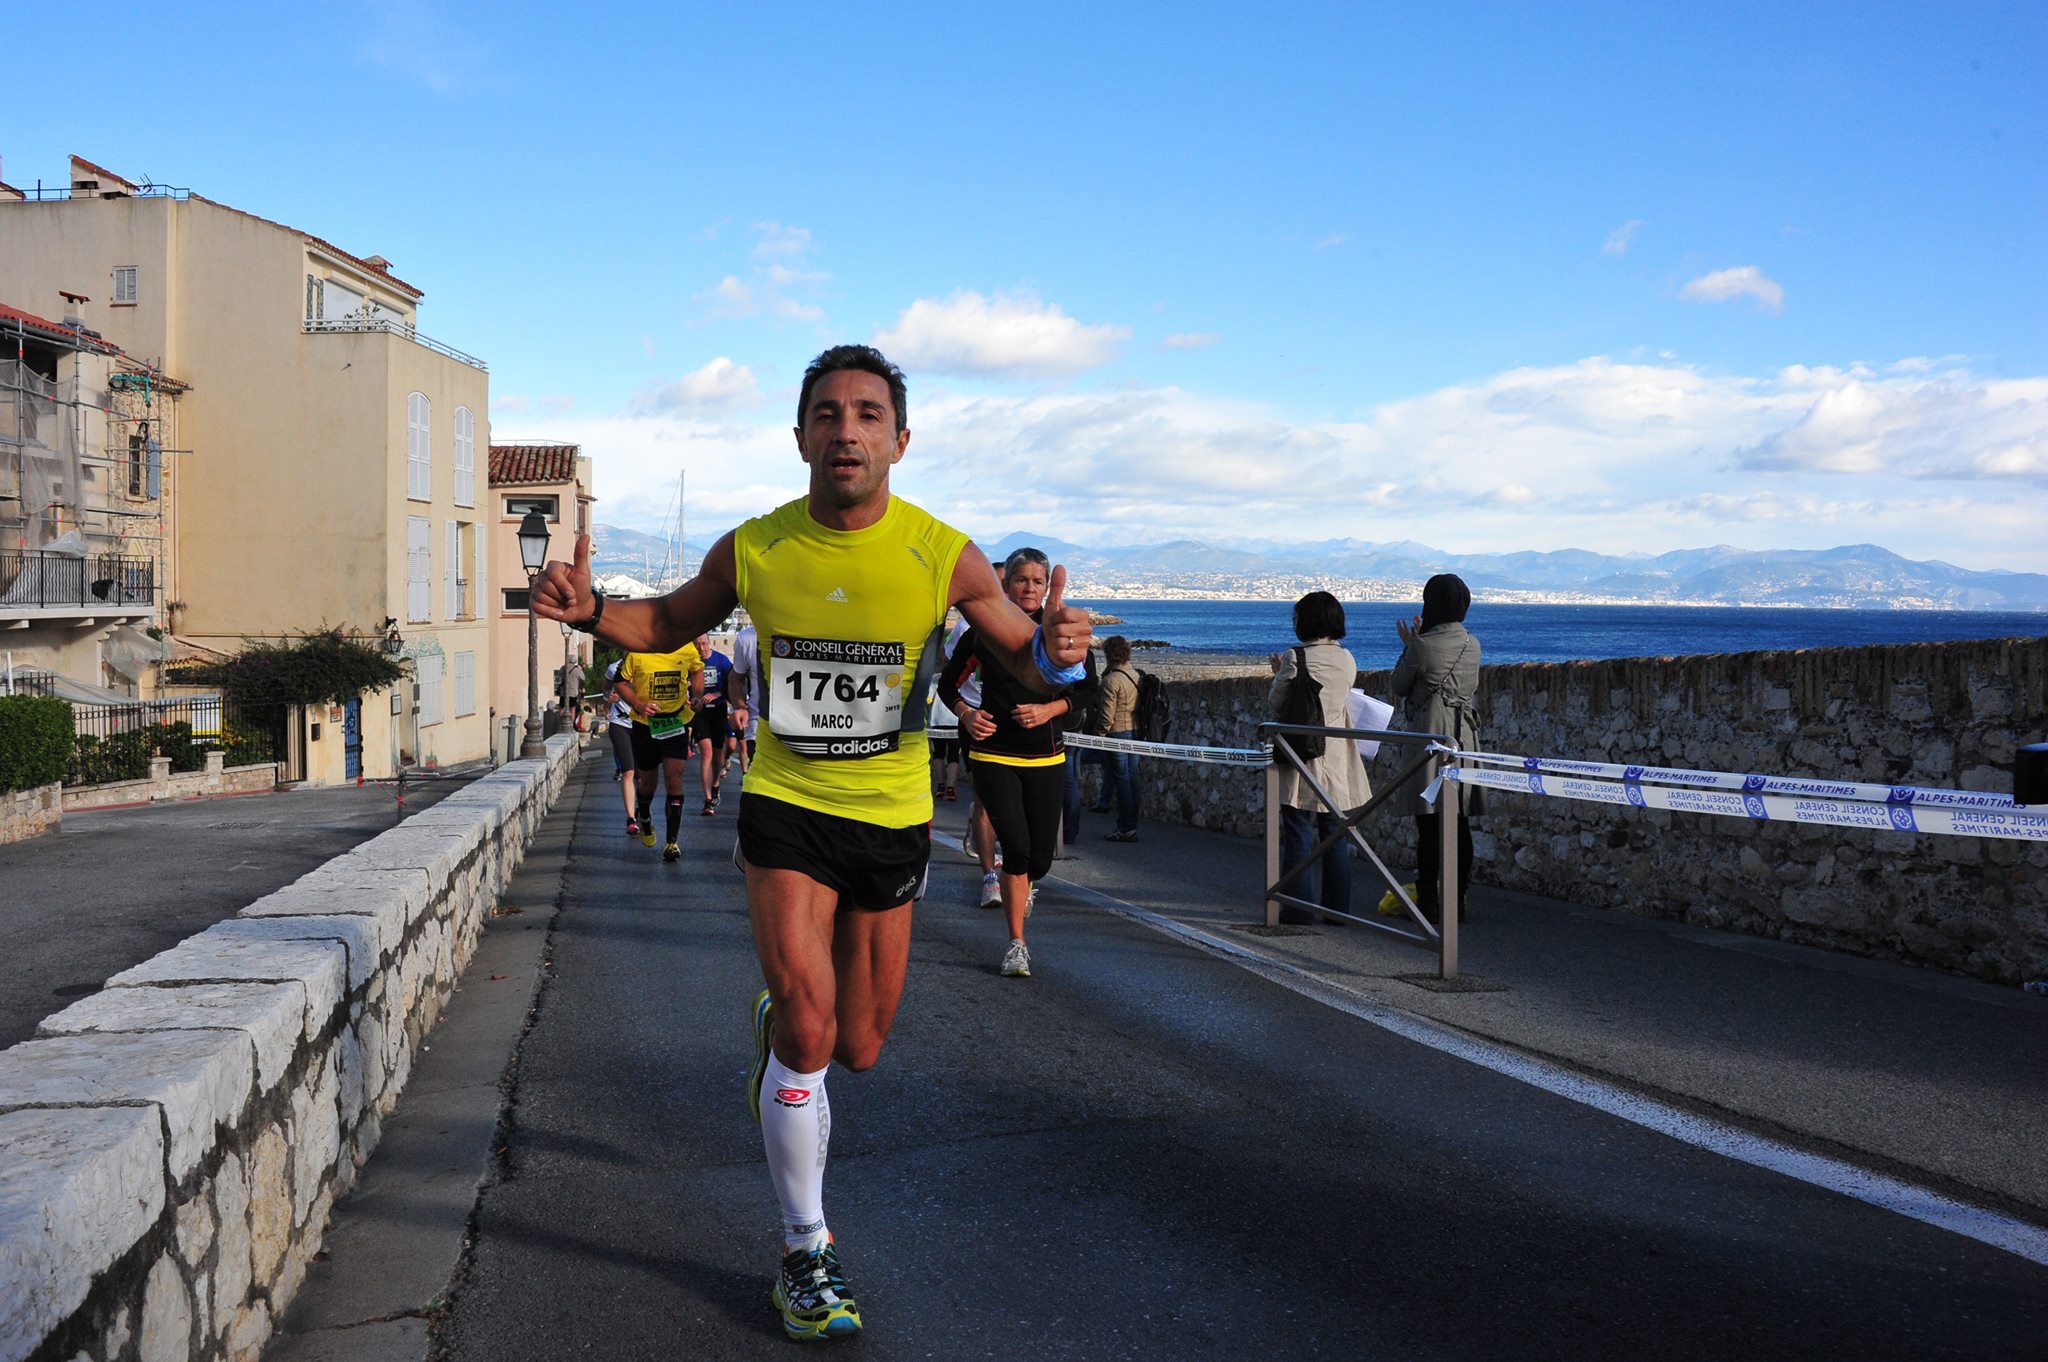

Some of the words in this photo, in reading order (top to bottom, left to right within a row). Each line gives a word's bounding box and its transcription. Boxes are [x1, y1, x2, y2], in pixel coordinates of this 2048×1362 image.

[794, 640, 844, 654] CONSEIL
[845, 642, 903, 656] GÉNÉRAL
[785, 670, 880, 703] 1764
[811, 714, 853, 729] MARCO
[830, 738, 889, 755] adidas
[1643, 771, 1718, 784] ALPES-MARITIMES
[1766, 781, 1857, 796] ALPES-MARITIMES
